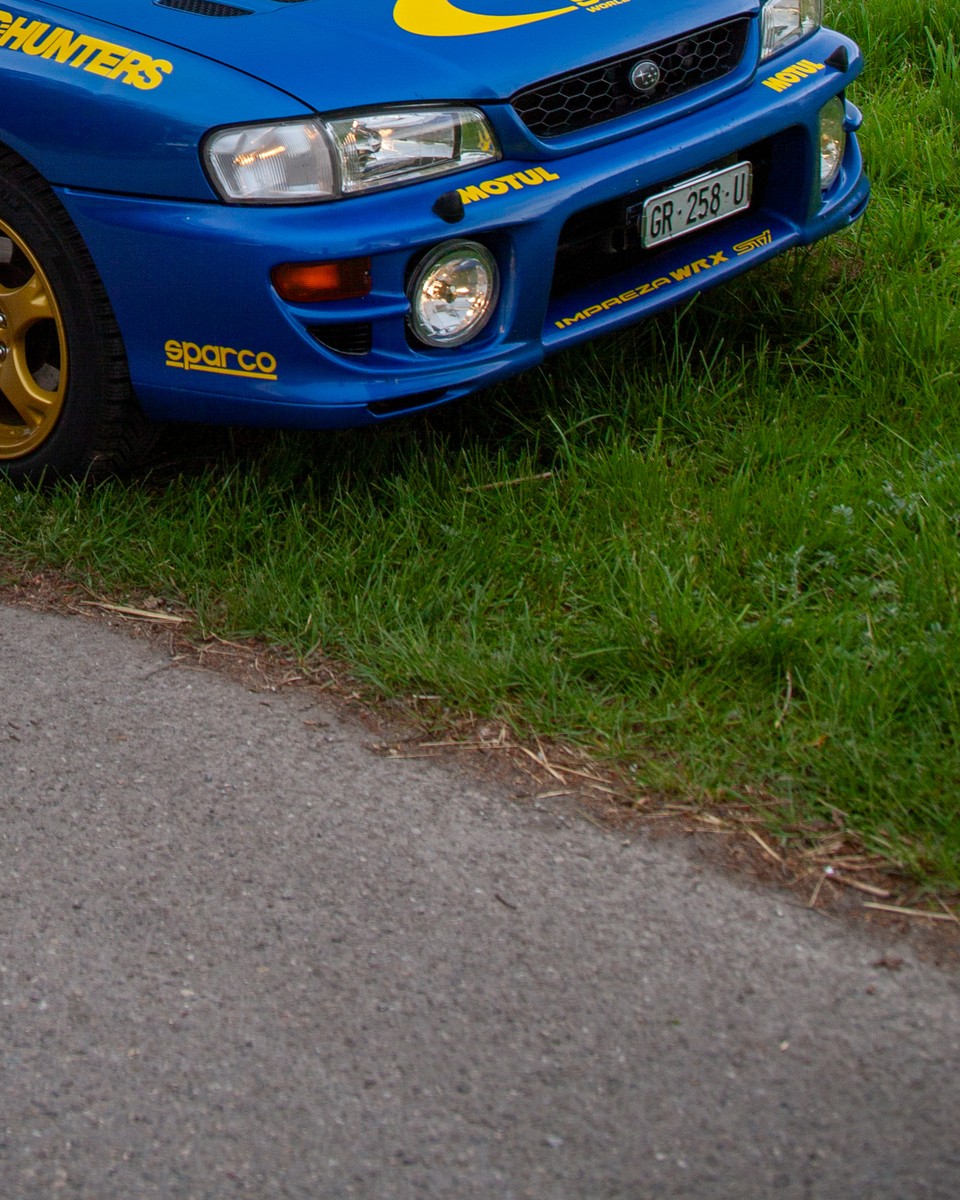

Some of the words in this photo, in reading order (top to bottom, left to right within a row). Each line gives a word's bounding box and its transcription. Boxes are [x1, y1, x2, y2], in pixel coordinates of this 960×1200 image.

[761, 59, 826, 93] MOTUL
[456, 166, 560, 205] MOTUL
[554, 276, 671, 329] IMPREZA
[669, 250, 729, 282] WRX
[164, 339, 277, 376] sparco
